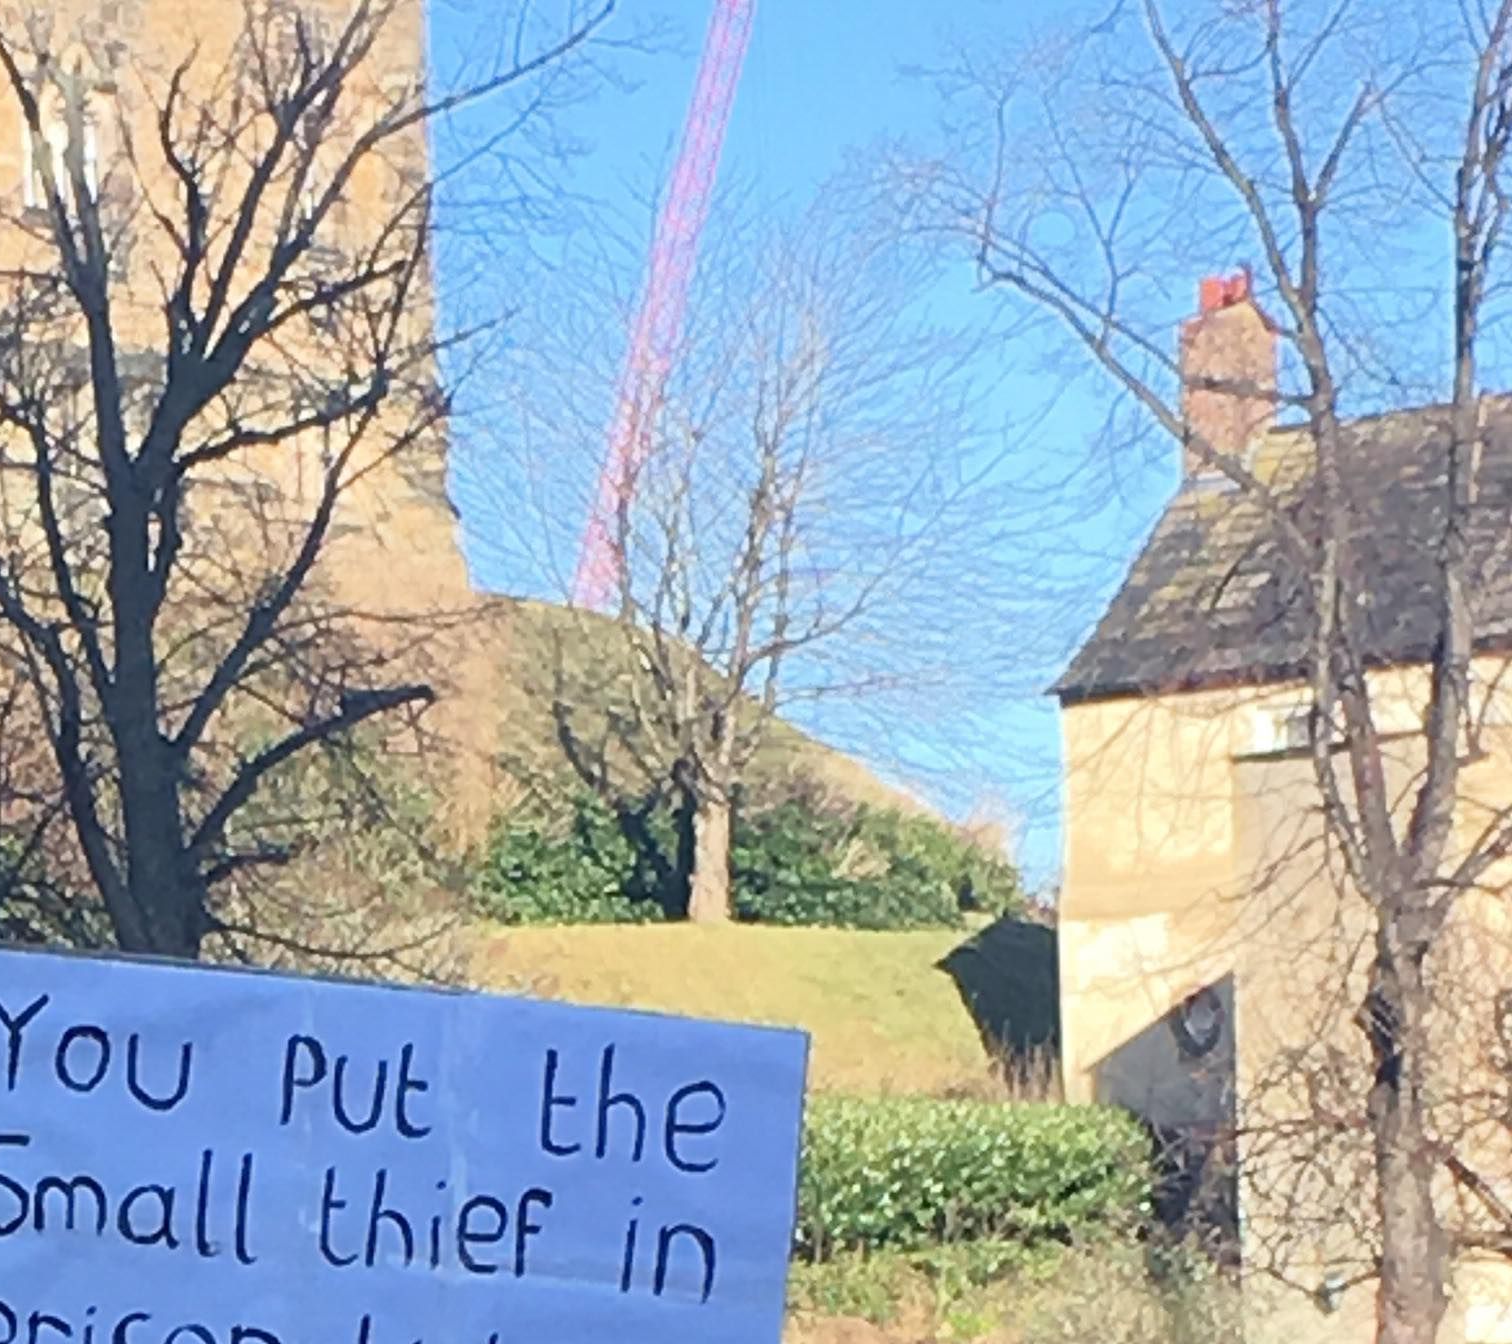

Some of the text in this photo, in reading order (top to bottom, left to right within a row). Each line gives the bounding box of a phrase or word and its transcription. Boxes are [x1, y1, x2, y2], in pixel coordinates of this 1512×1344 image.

[542, 1044, 727, 1172] the
[320, 1167, 552, 1277] thief
[622, 1196, 717, 1303] in
